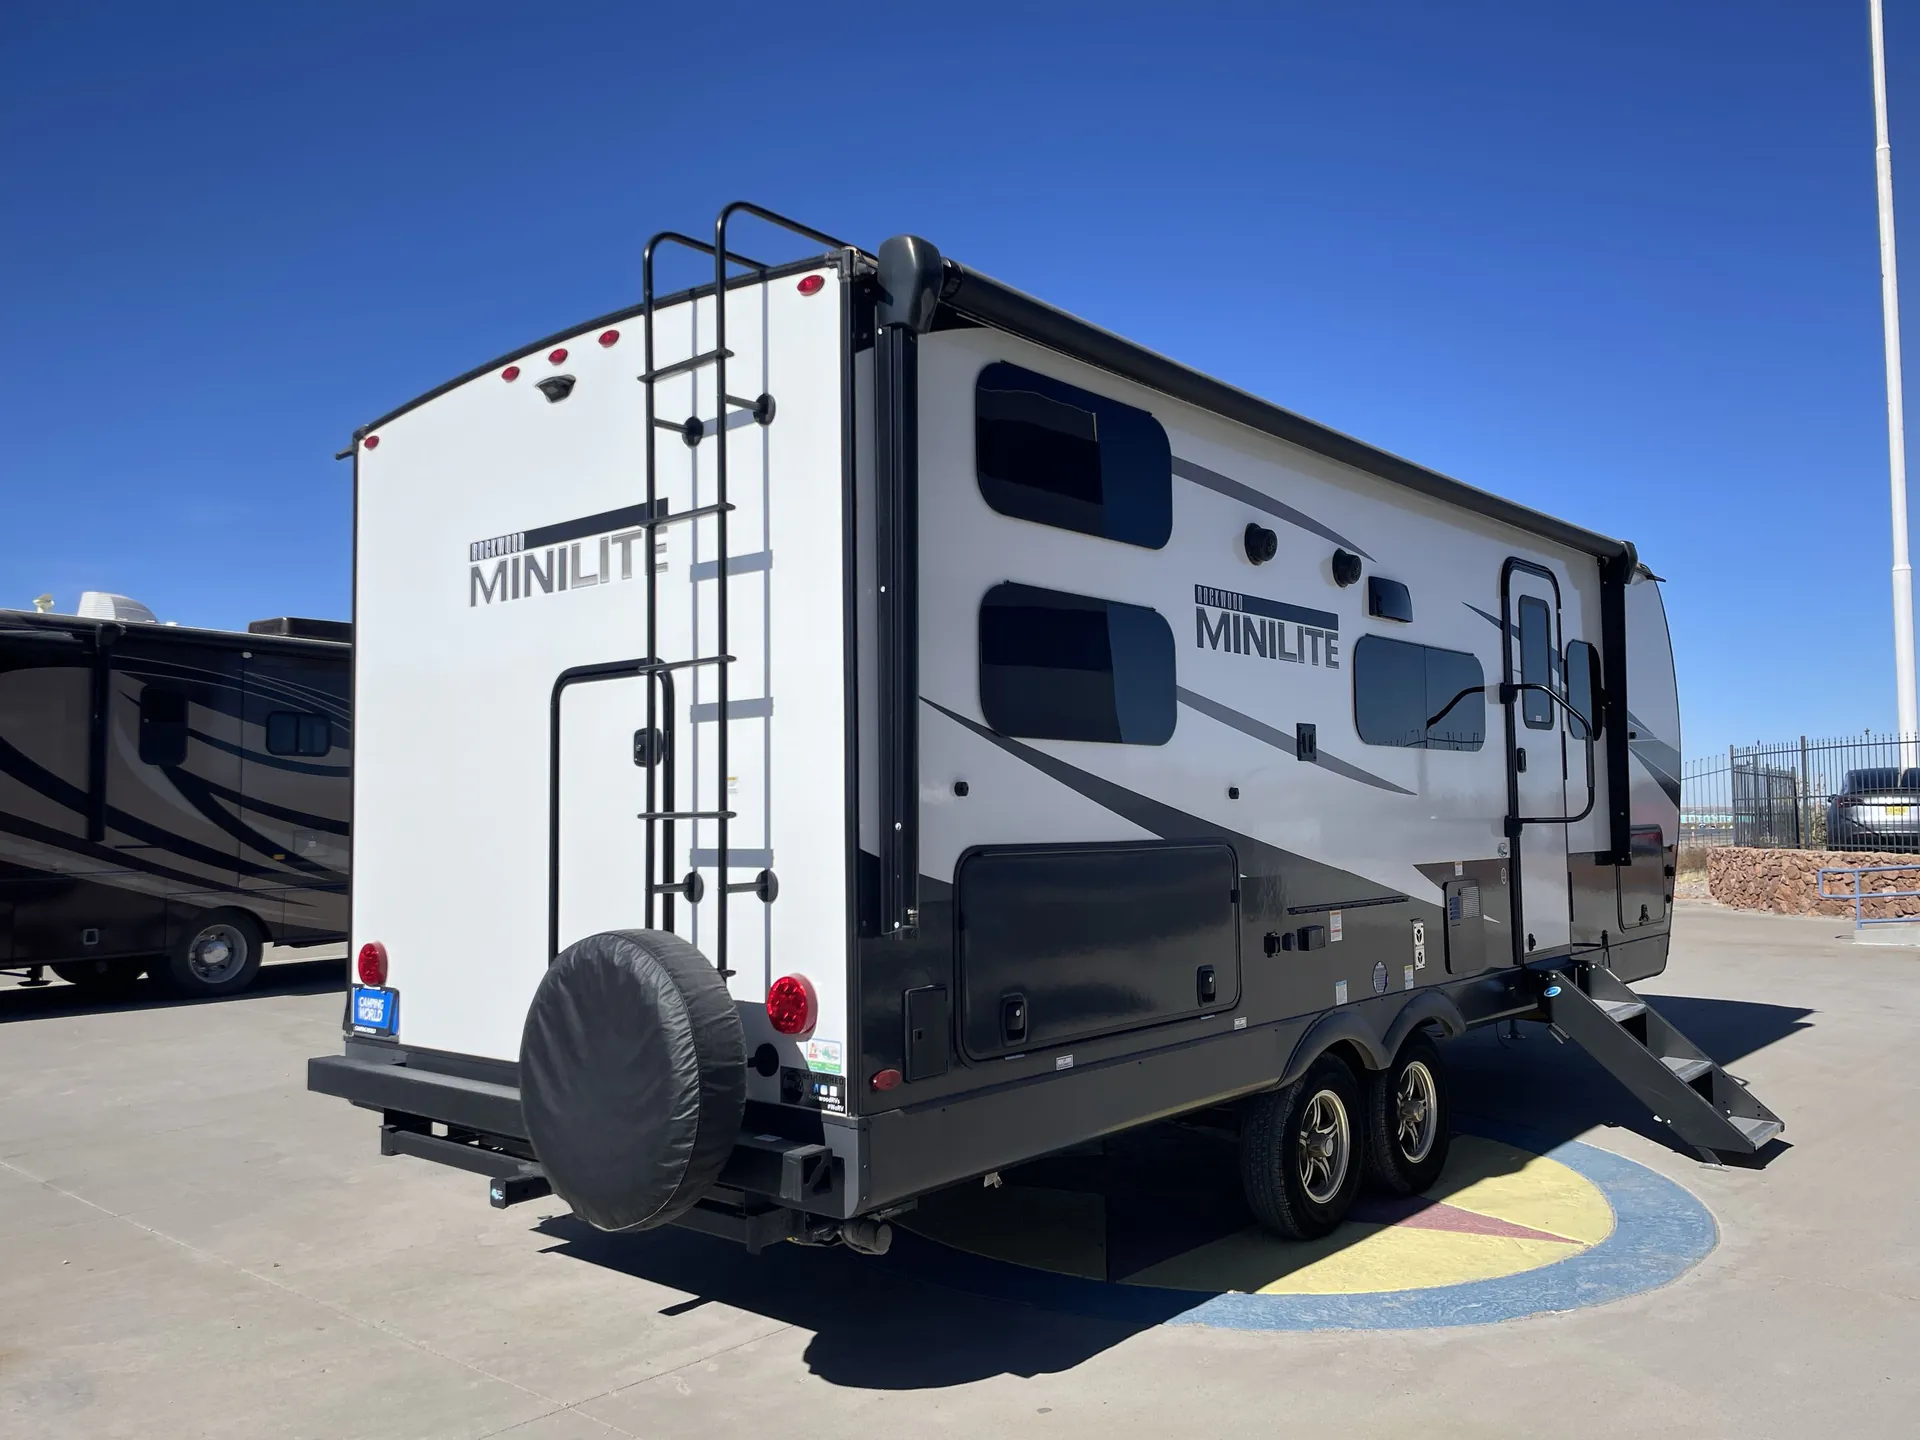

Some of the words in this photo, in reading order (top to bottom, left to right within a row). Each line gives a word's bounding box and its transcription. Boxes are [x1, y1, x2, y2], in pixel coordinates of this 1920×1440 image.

[471, 532, 525, 561] ROCKWOOD
[470, 526, 669, 608] MINILITE
[1197, 586, 1243, 611] ROCKWOOD
[1196, 606, 1340, 669] MINILITE
[358, 1007, 383, 1022] WORLD
[359, 997, 384, 1010] CAMPING
